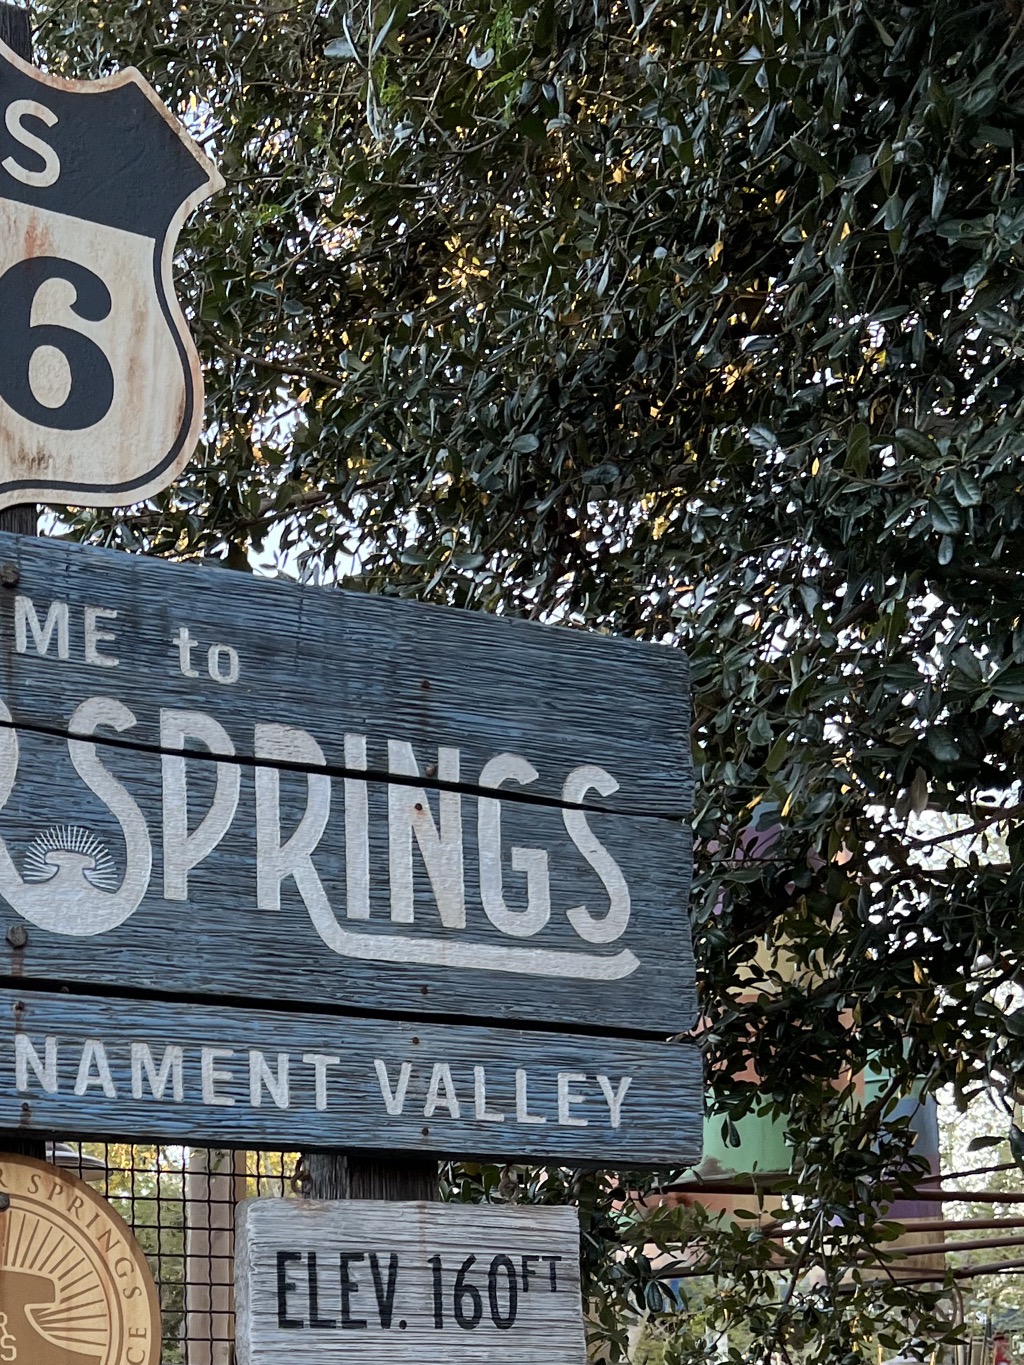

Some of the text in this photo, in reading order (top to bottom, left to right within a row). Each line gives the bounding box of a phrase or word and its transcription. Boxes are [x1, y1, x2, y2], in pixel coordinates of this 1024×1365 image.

[174, 626, 241, 684] to
[31, 696, 640, 980] SPRINGS
[374, 1058, 633, 1130] VALLEY
[27, 1173, 142, 1300] SPRINGS
[276, 1251, 407, 1330] ELEV.
